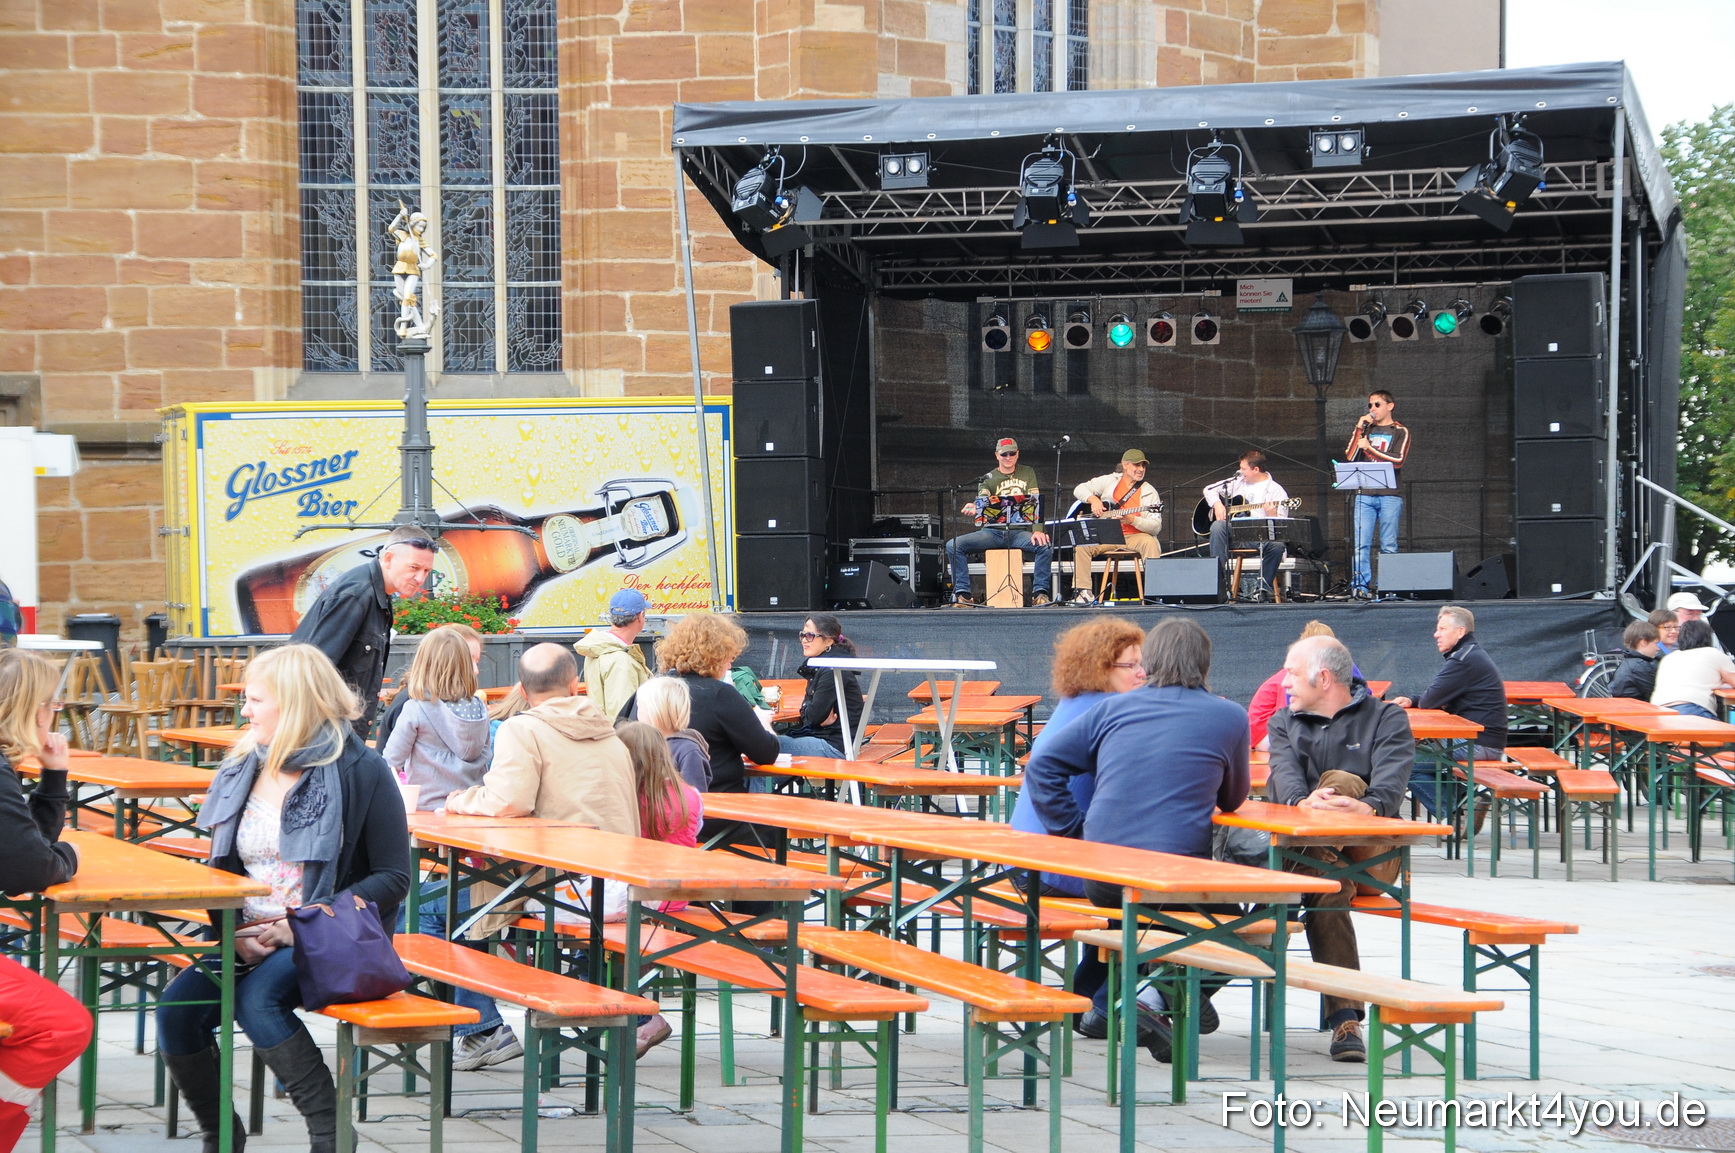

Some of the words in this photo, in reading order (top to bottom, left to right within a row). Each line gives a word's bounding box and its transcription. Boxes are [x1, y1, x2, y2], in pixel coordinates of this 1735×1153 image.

[224, 449, 359, 522] Glossner
[296, 488, 358, 518] Bier
[551, 531, 567, 558] GOLD
[556, 518, 577, 567] NEUMARKTER
[620, 573, 652, 591] Der
[655, 573, 712, 596] hochfein
[642, 592, 709, 615] ergenuss
